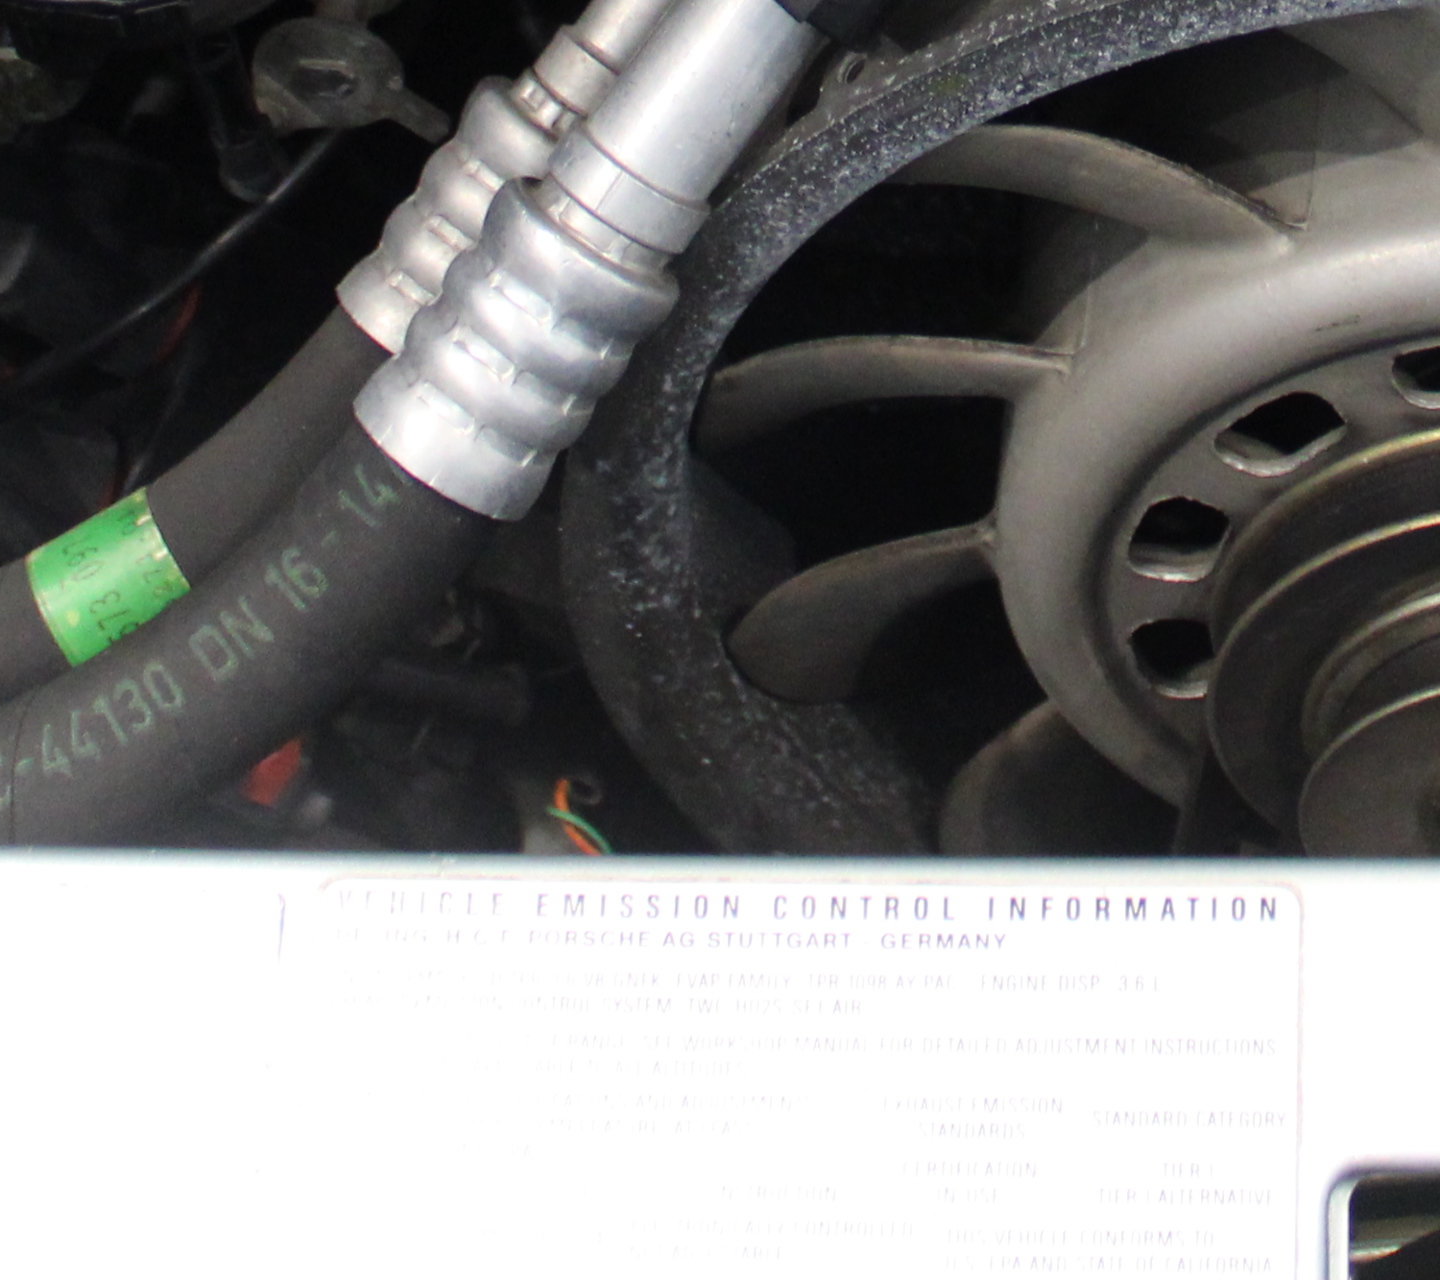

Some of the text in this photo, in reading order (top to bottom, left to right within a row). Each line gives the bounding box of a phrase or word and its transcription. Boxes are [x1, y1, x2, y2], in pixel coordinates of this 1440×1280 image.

[189, 596, 277, 683] DN
[264, 545, 330, 611] 16
[338, 464, 398, 528] 14
[537, 893, 739, 919] EMISSION
[773, 895, 953, 920] CONTROL
[988, 896, 1276, 921] INFORMATION
[529, 930, 649, 947] PORSCHE
[662, 931, 695, 948] AG
[708, 932, 850, 948] STUTTGART
[880, 933, 1005, 949] GERMANY
[1015, 1037, 1135, 1055] ADJUSTMENT
[1144, 1038, 1275, 1055] INSTRUCTIONS
